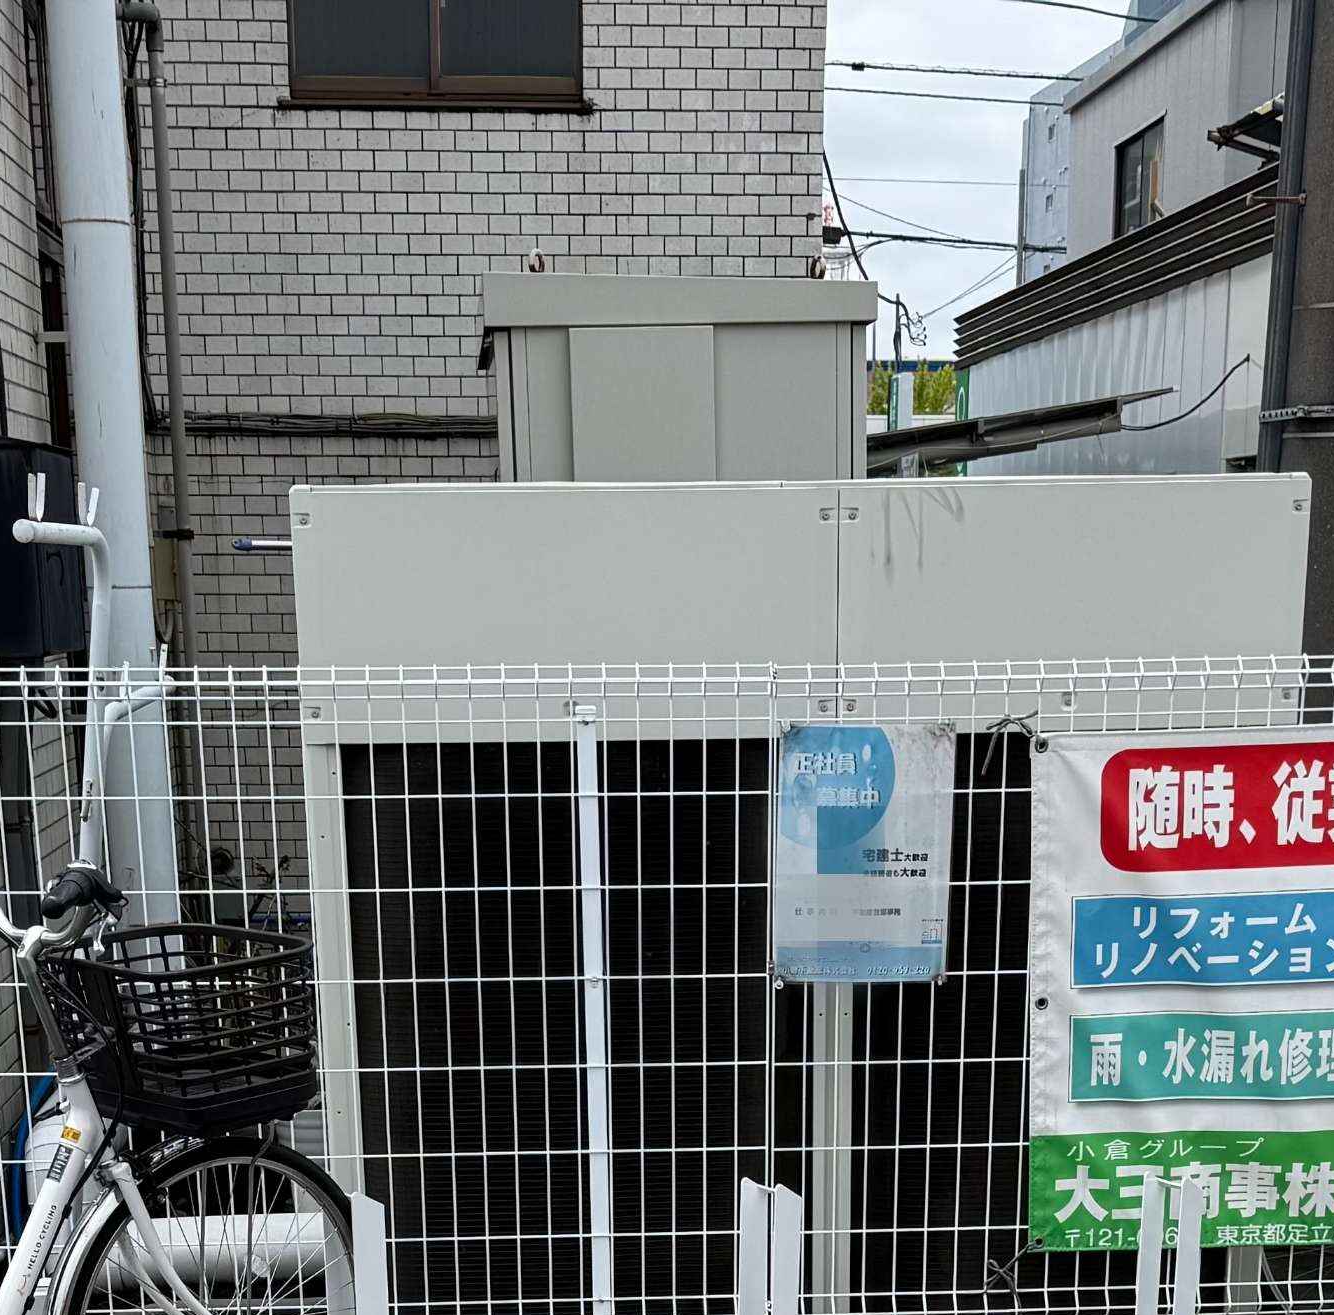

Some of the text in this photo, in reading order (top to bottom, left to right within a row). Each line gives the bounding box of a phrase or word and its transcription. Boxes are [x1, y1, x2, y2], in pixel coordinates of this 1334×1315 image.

[795, 752, 857, 776] 正社員
[1133, 903, 1317, 939] リフォーム
[1066, 1137, 1265, 1161] 小倉グループ
